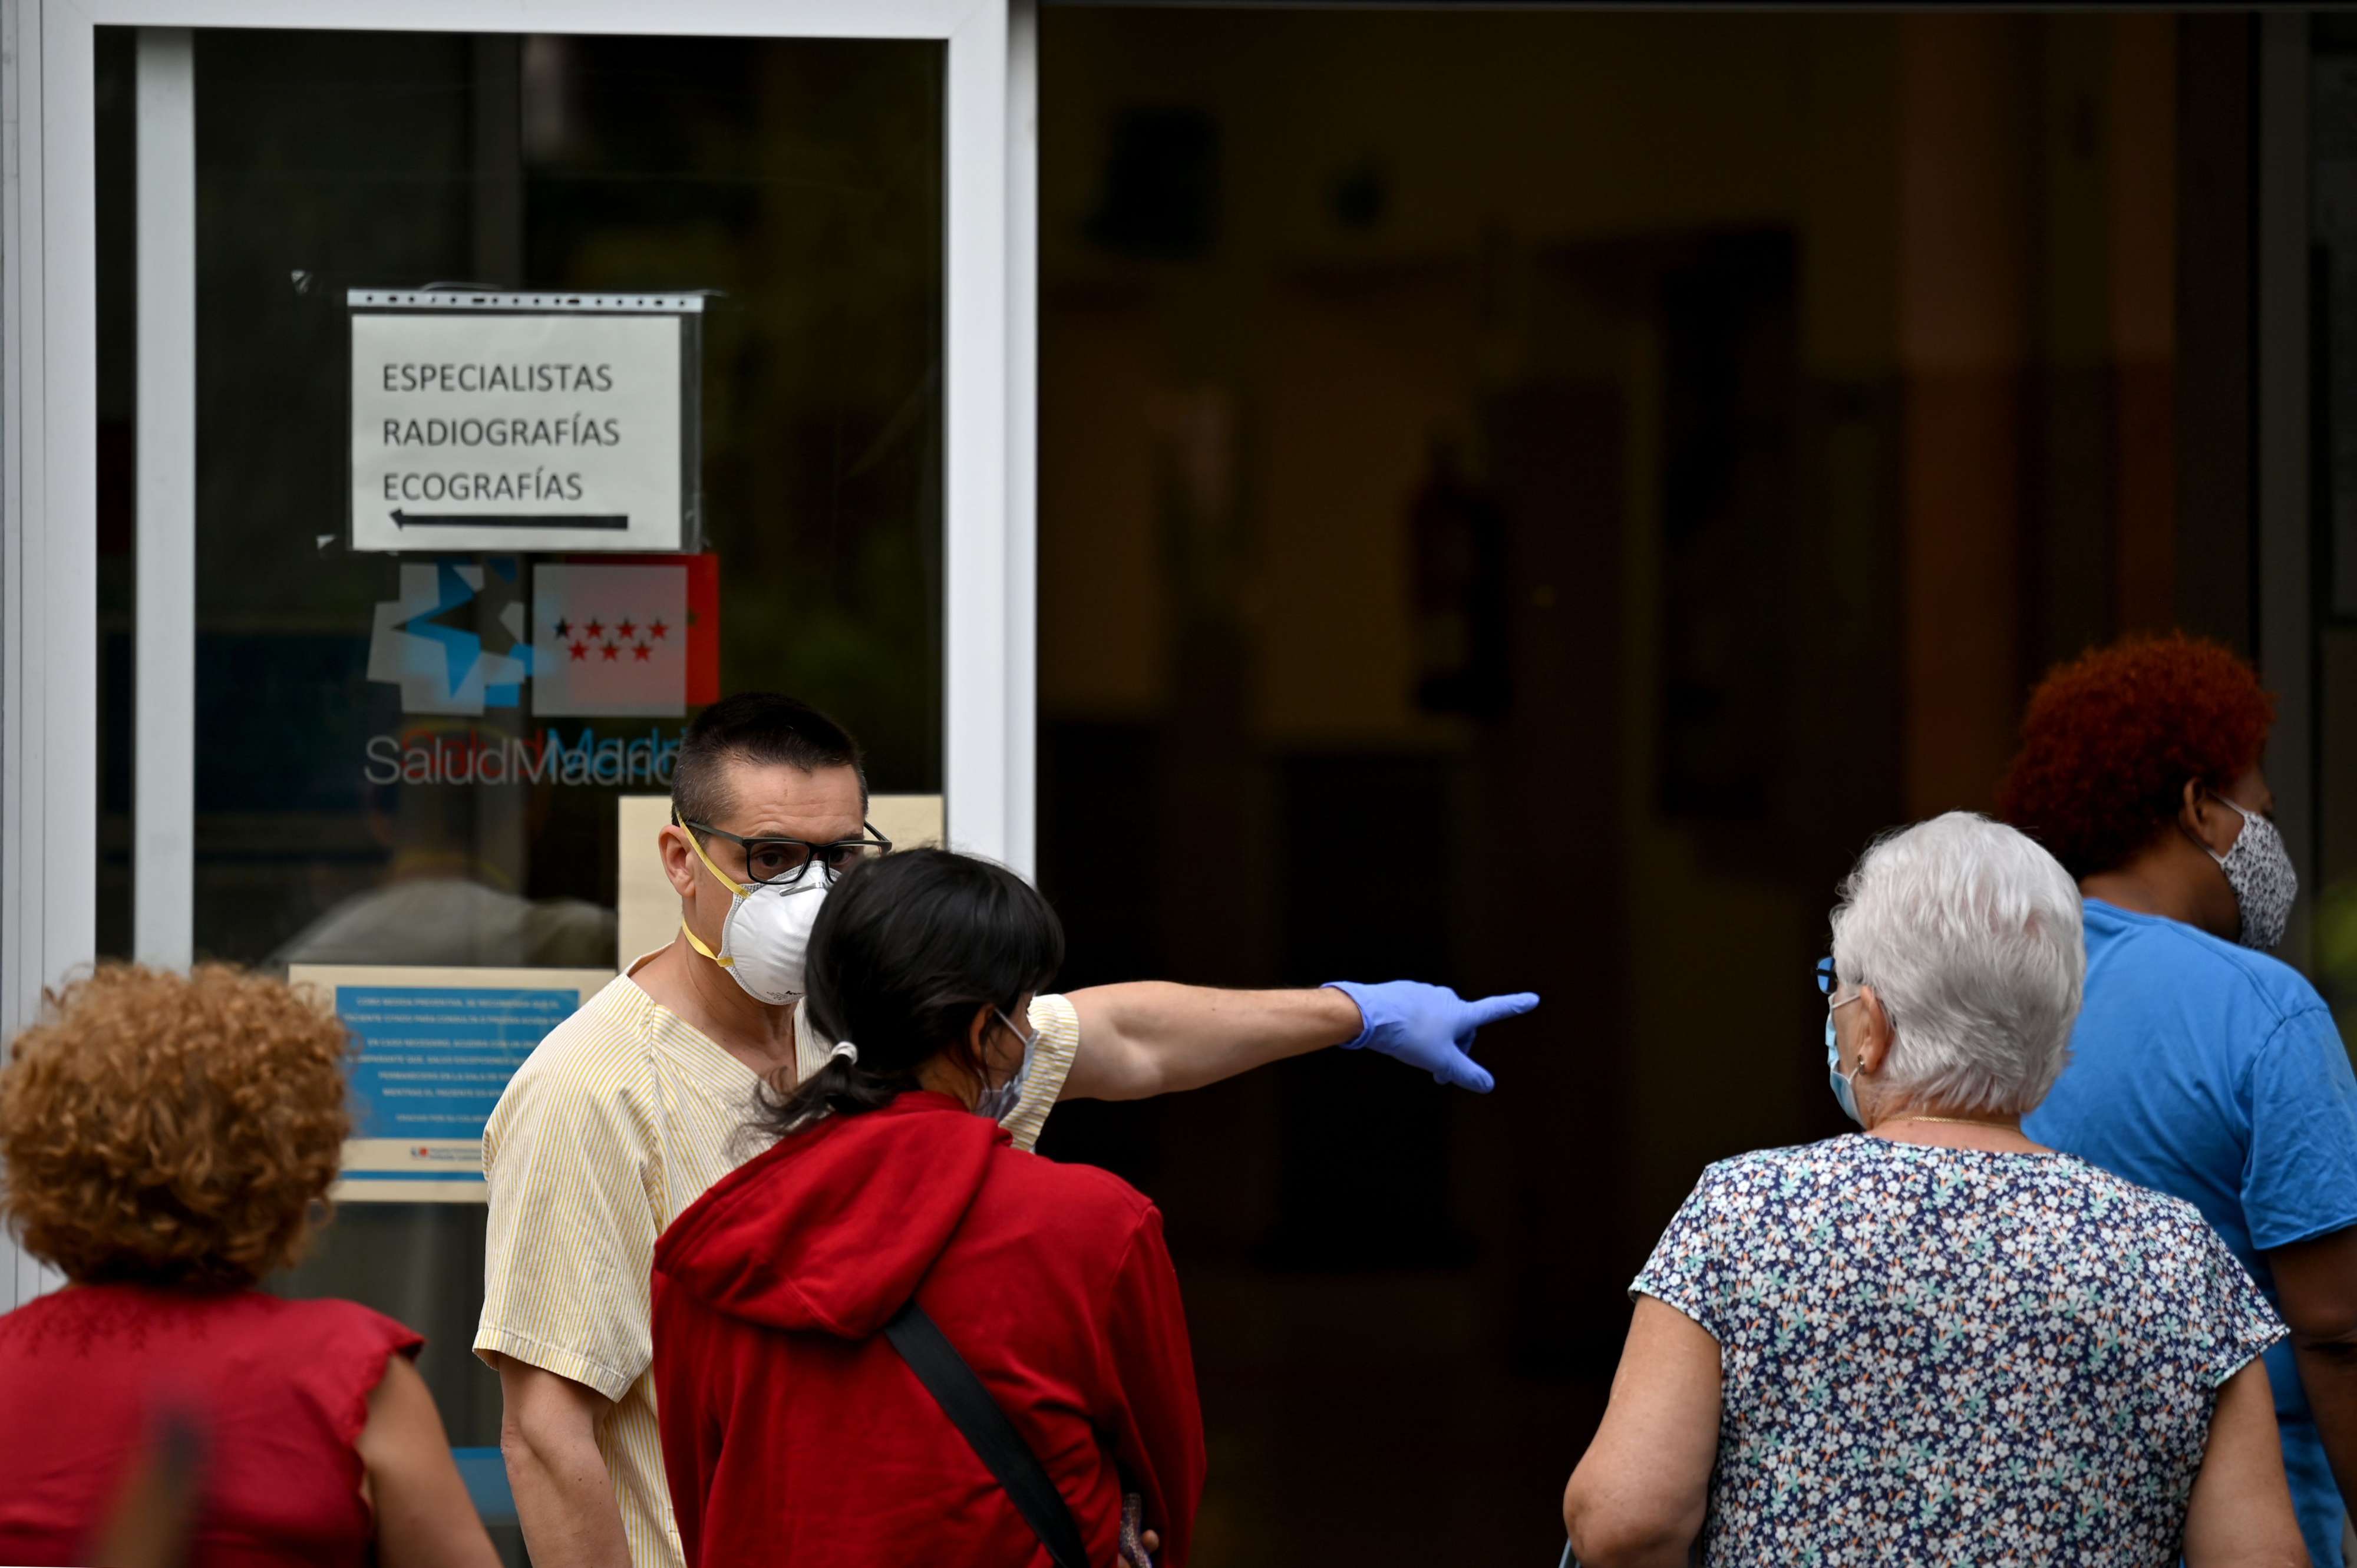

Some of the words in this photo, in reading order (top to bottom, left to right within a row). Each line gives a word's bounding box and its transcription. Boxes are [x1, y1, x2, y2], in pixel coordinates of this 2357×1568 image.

[383, 363, 613, 392] ESPECIALISTAS
[383, 412, 620, 447] RADIOGRAFÍAS
[383, 466, 583, 501] ECOGRAFÍAS
